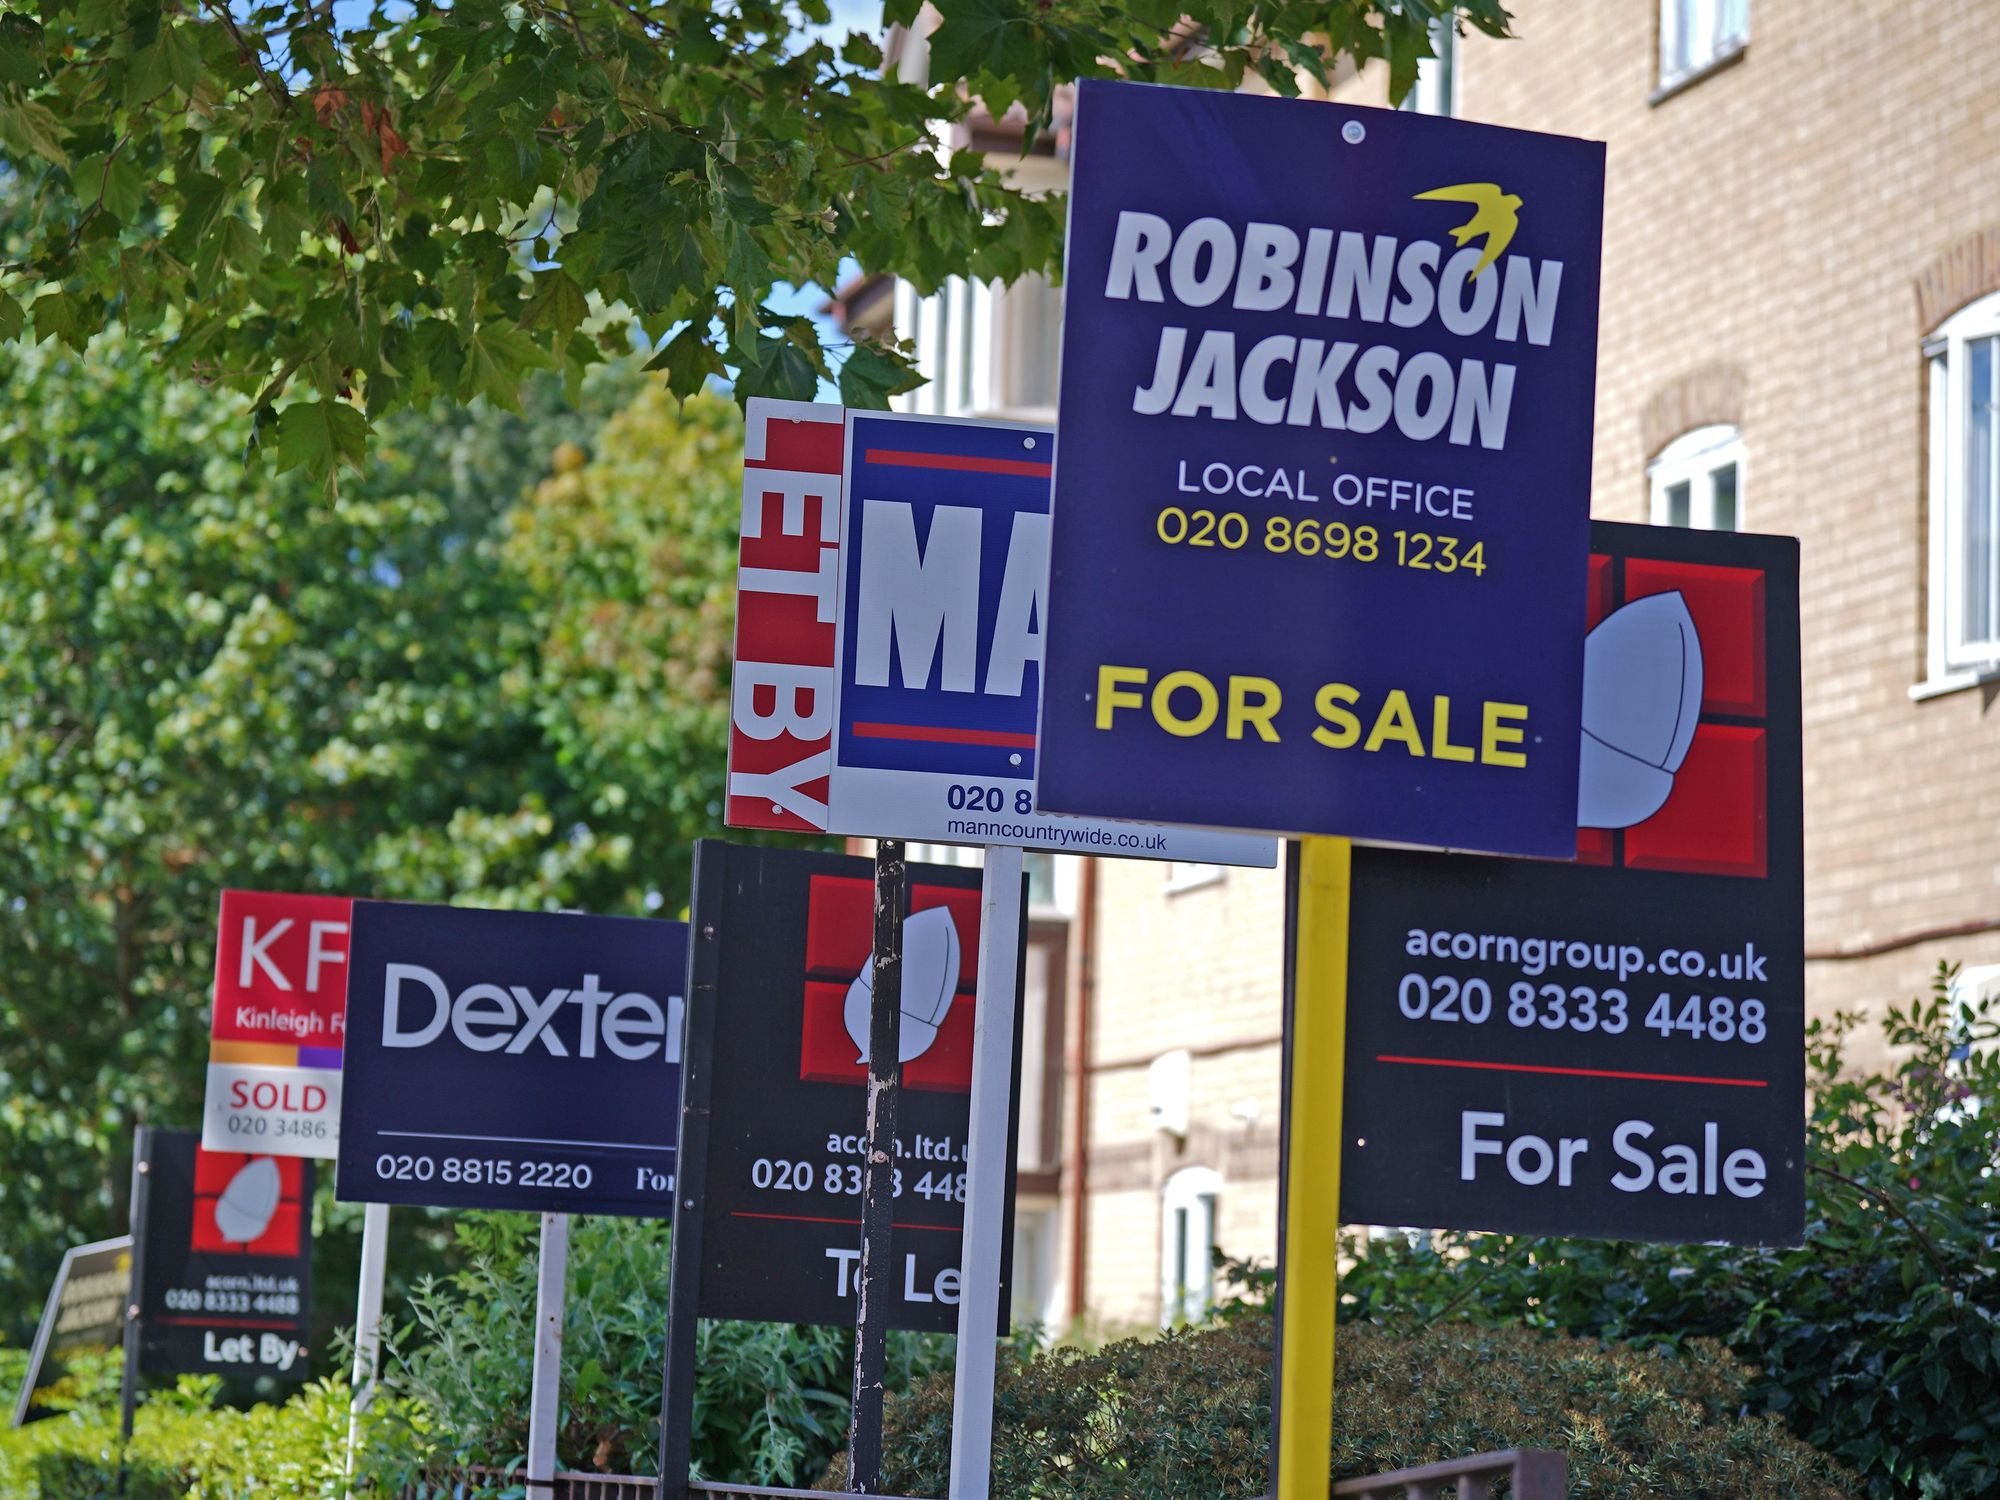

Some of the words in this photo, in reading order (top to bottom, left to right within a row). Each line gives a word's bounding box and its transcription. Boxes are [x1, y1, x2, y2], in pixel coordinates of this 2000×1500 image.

[1104, 211, 1563, 347] ROBINSON
[1133, 326, 1516, 450] JACKSON
[738, 397, 844, 623] LET
[1178, 460, 1319, 502] LOCAL
[1333, 474, 1475, 521] OFFICE
[1157, 507, 1249, 549] 020
[1264, 517, 1379, 562] 8698
[1394, 530, 1487, 577] 1234
[1095, 665, 1283, 744] FOR
[1312, 683, 1529, 768] SALE
[730, 660, 834, 832] BY
[947, 785, 1004, 813] 020
[948, 820, 1167, 850] manncountrywide.co.uk
[1405, 928, 1768, 982] acorngroup.co.uk
[235, 1006, 324, 1037] Kinleigh
[1399, 972, 1492, 1024] 020
[1507, 981, 1629, 1034] 8333
[1644, 992, 1767, 1044] 4488
[230, 1080, 326, 1112] SOLD
[228, 1115, 266, 1134] 020
[275, 1118, 326, 1138] 3486
[376, 1154, 434, 1181] 020
[441, 1157, 512, 1185] 8815
[518, 1161, 593, 1190] 2220
[752, 1158, 814, 1192] 020
[1461, 1110, 1587, 1187] For
[1610, 1119, 1766, 1198] Sale
[825, 1247, 860, 1297] T
[165, 1288, 202, 1311] 020
[204, 1291, 250, 1313] 8333
[253, 1294, 300, 1315] 4488
[204, 1331, 255, 1363] Let
[260, 1333, 299, 1371] By
